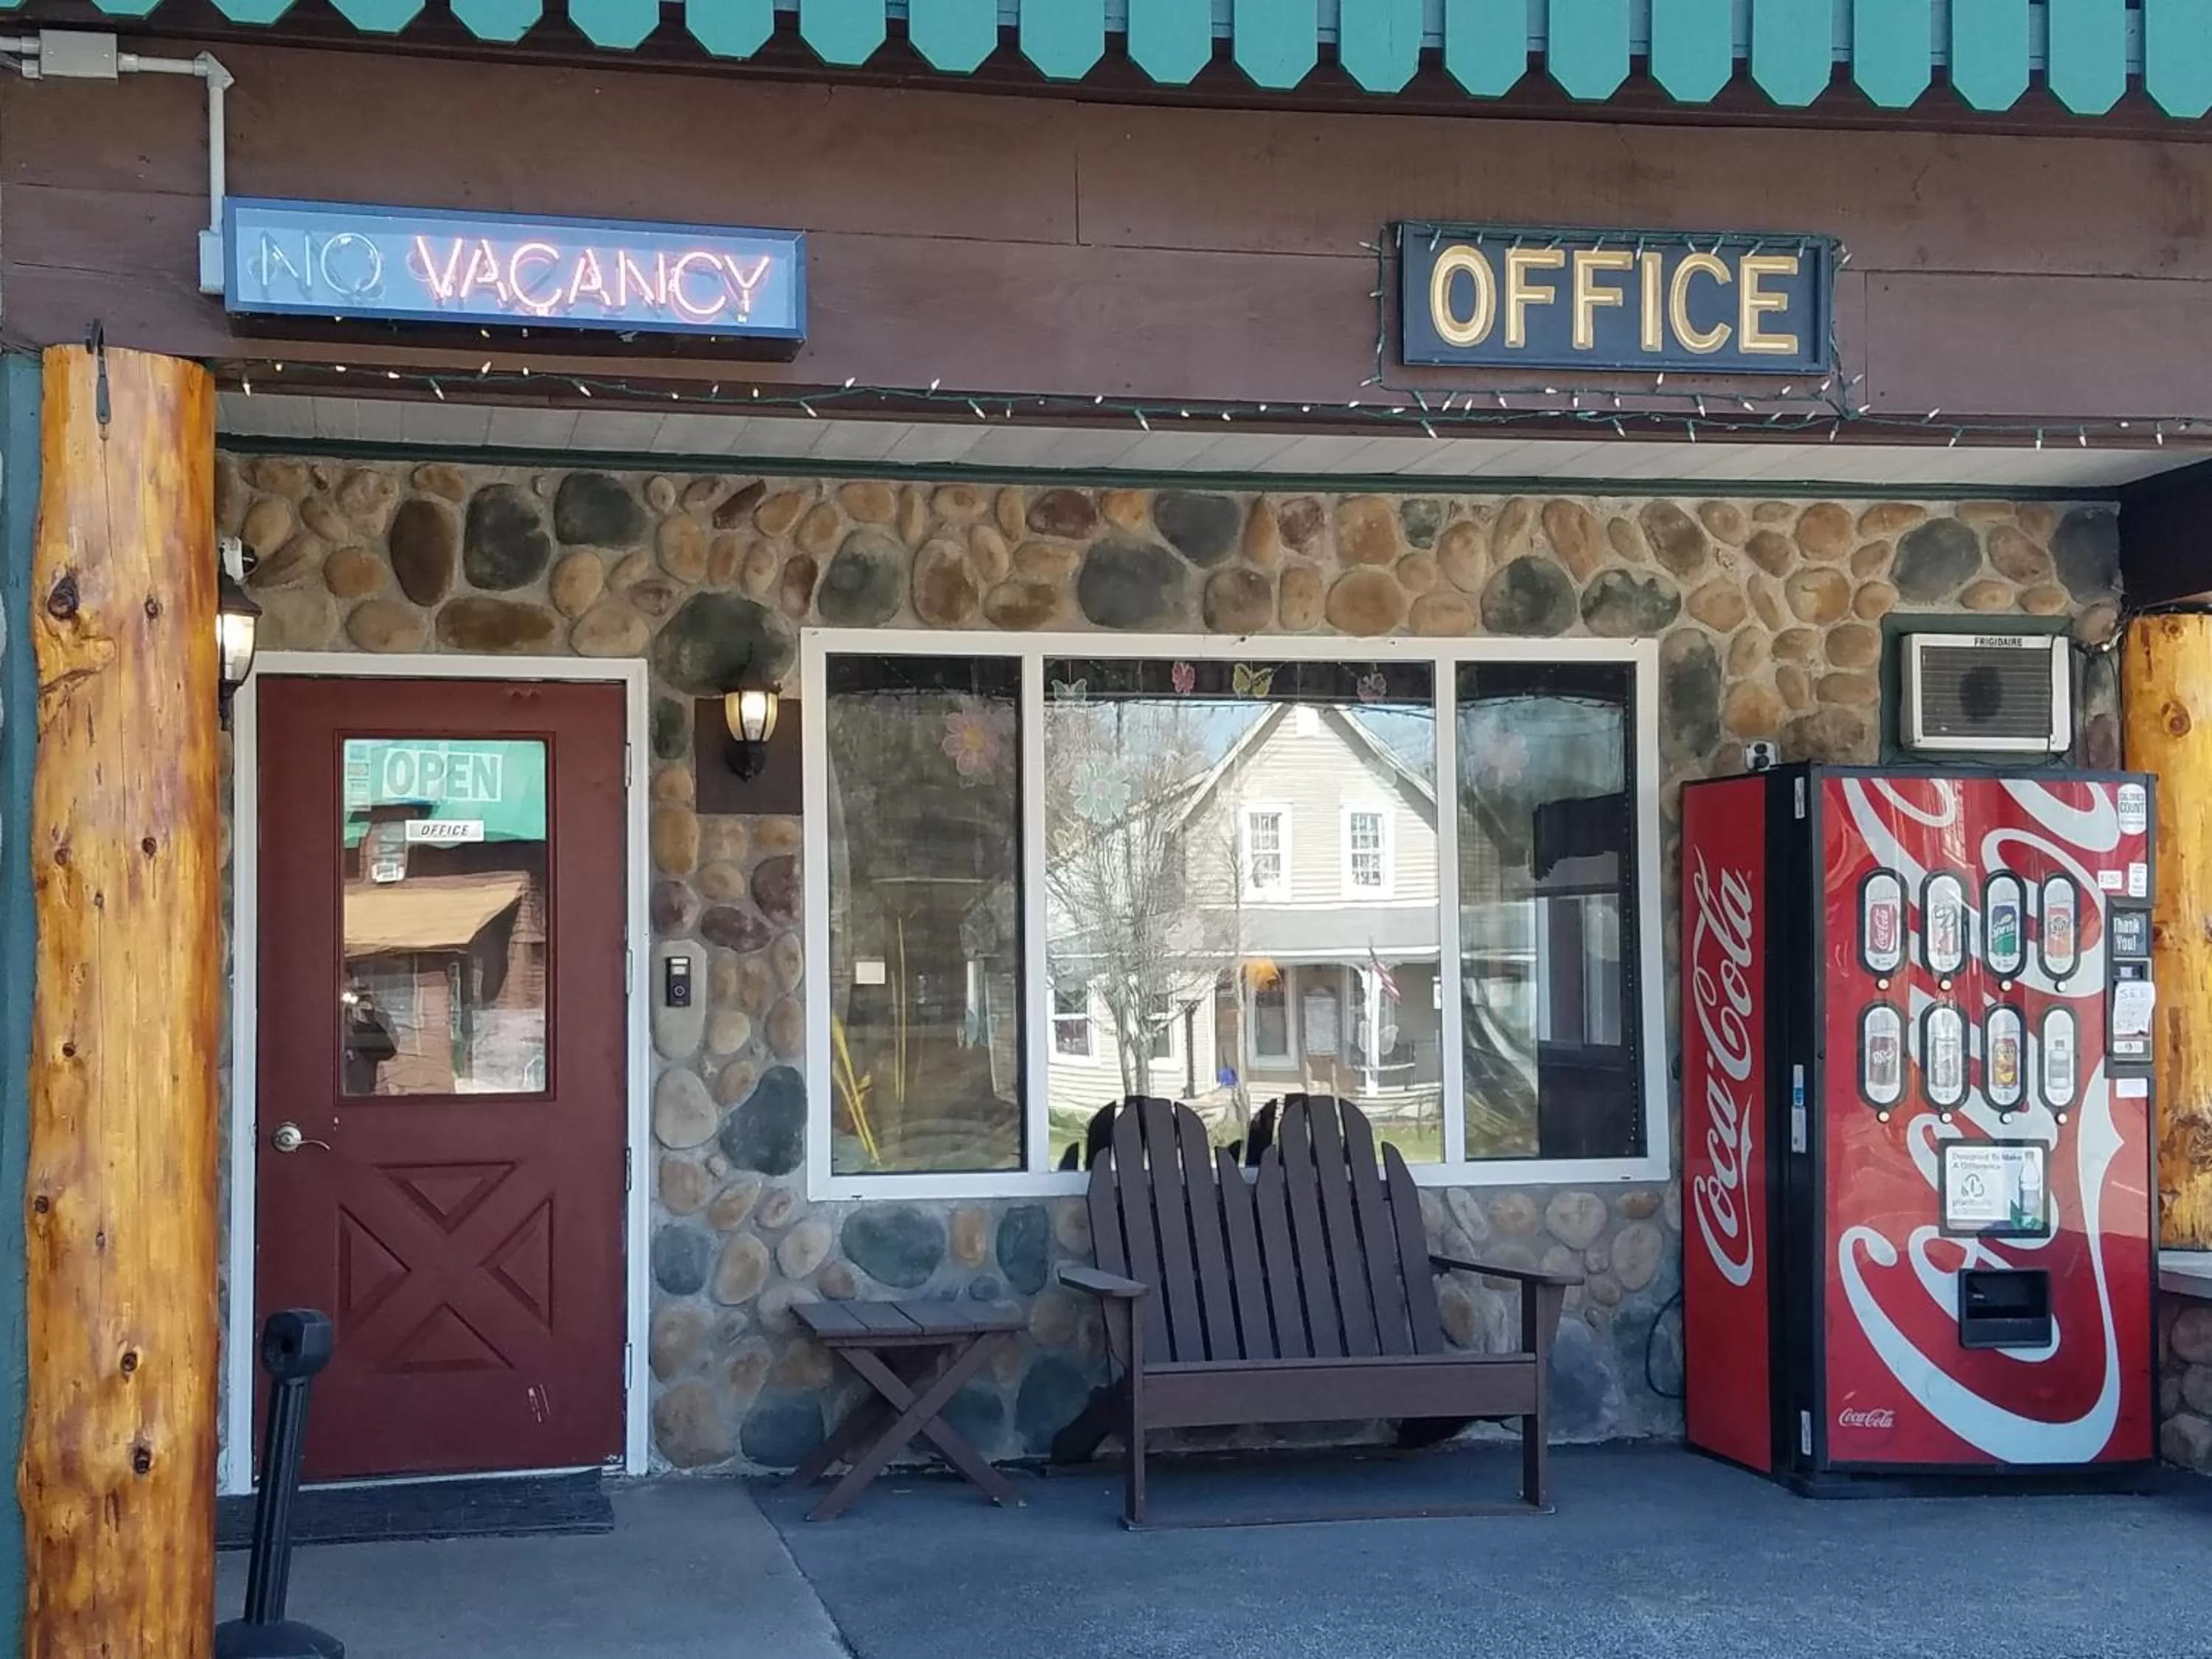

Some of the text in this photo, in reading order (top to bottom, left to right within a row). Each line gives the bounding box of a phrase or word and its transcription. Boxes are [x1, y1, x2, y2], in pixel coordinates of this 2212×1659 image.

[260, 232, 772, 323] NO VACANCY
[1429, 244, 1798, 355] OFFICE
[1974, 637, 2023, 647] FRIGIDAIRE
[386, 751, 499, 800] OPEN
[420, 824, 470, 836] OFFICE
[2113, 917, 2140, 933] Thank
[2115, 934, 2137, 951] You!
